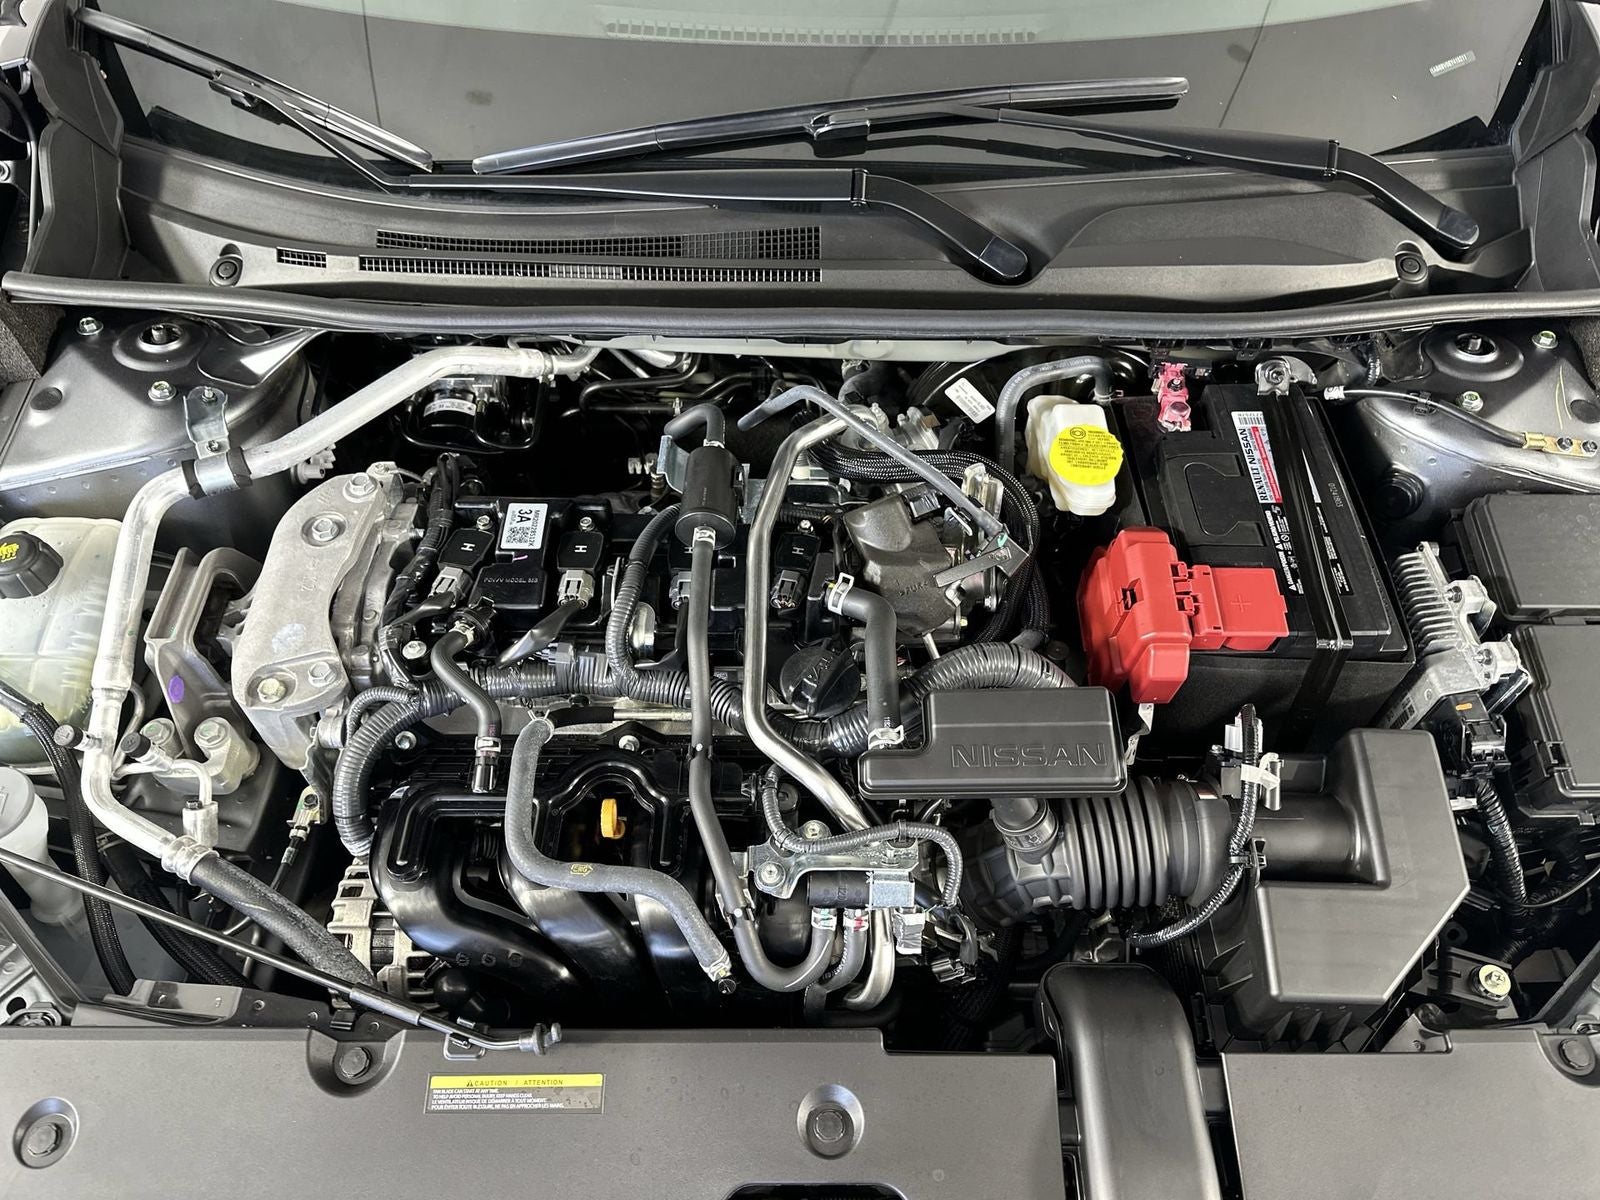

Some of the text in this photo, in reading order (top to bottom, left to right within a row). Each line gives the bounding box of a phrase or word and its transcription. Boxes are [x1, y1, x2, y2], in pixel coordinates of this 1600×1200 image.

[1238, 428, 1256, 465] NISSAN
[1251, 468, 1268, 502] RENAULT
[516, 508, 533, 524] 3A
[460, 542, 476, 551] H
[574, 545, 588, 553] H
[951, 743, 1108, 768] NISSAN
[474, 1079, 508, 1087] CAUTION
